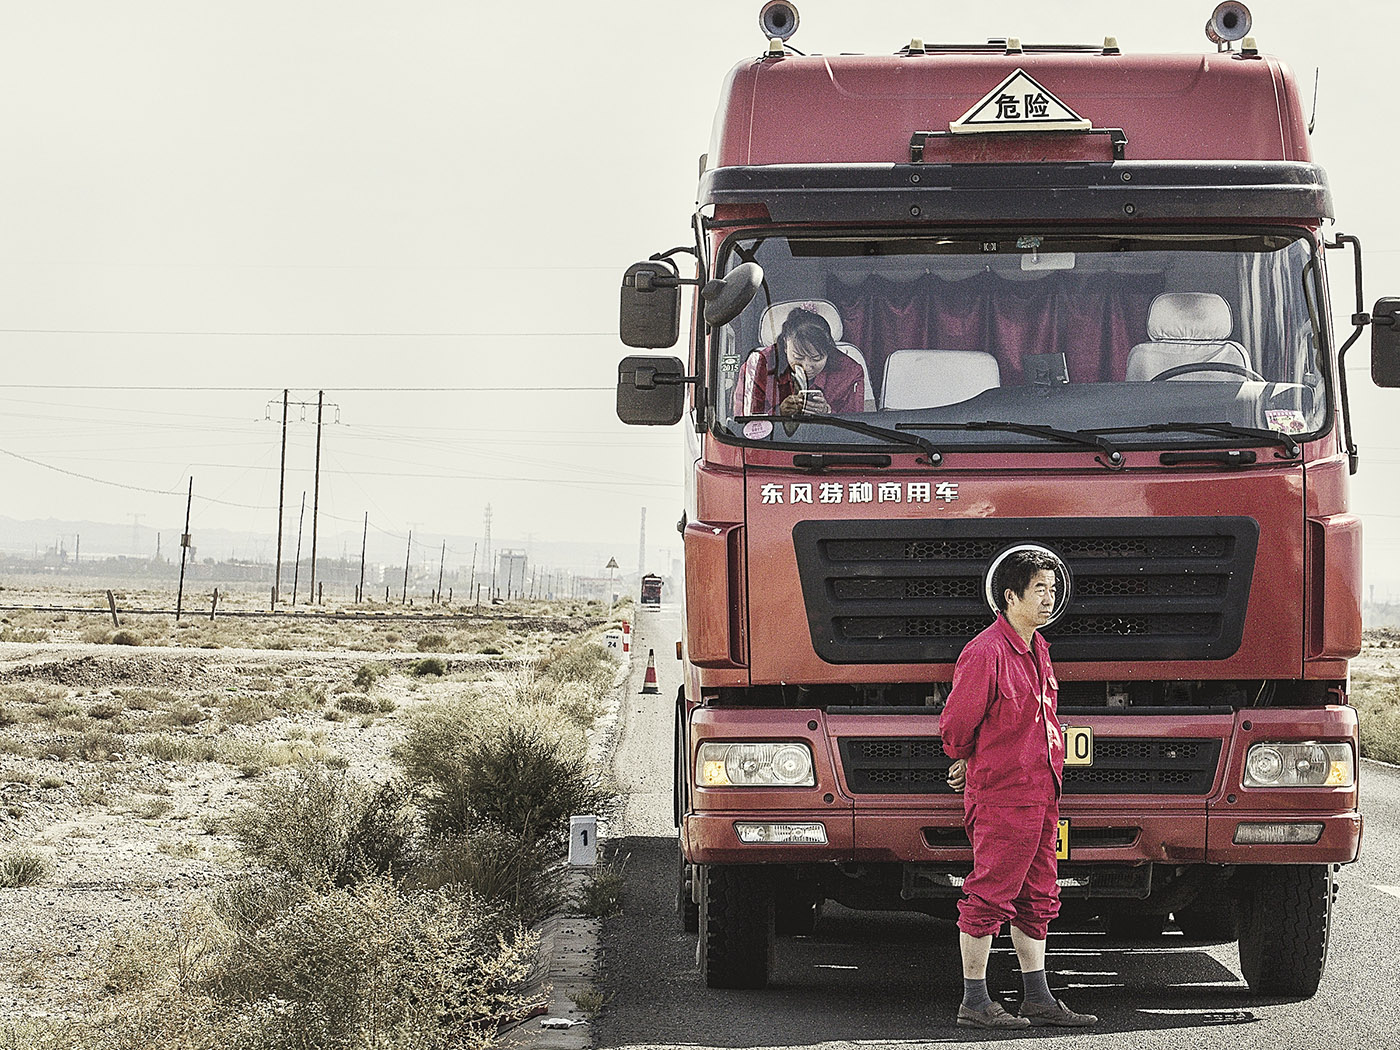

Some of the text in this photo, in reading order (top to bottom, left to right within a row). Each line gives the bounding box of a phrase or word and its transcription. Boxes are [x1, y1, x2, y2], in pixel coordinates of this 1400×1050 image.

[995, 93, 1050, 119] 危险
[760, 482, 959, 504] 东风特种商用车
[581, 830, 588, 846] 1
